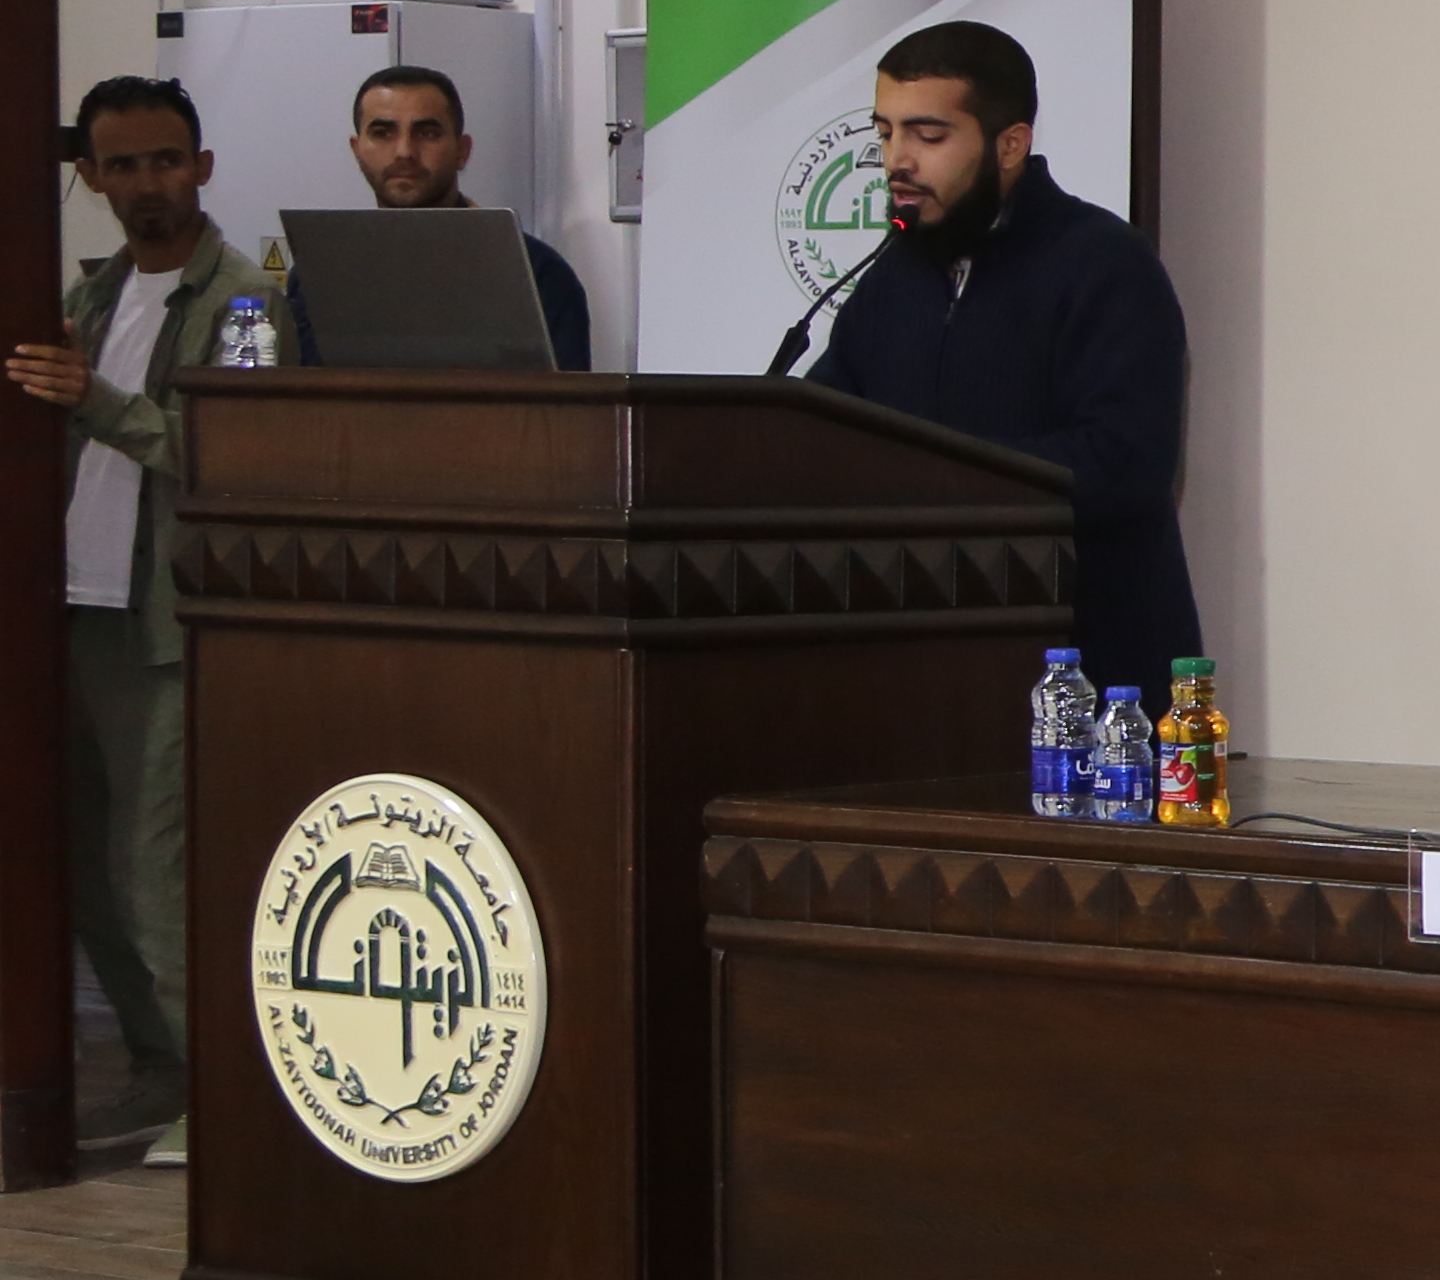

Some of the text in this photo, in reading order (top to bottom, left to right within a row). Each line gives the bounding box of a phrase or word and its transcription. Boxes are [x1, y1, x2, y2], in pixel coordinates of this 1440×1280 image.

[787, 238, 844, 311] AL-ZAYTONA
[268, 1004, 520, 1165] AL-ZAYTOONAH UNIVERSITY OF JORDAN
